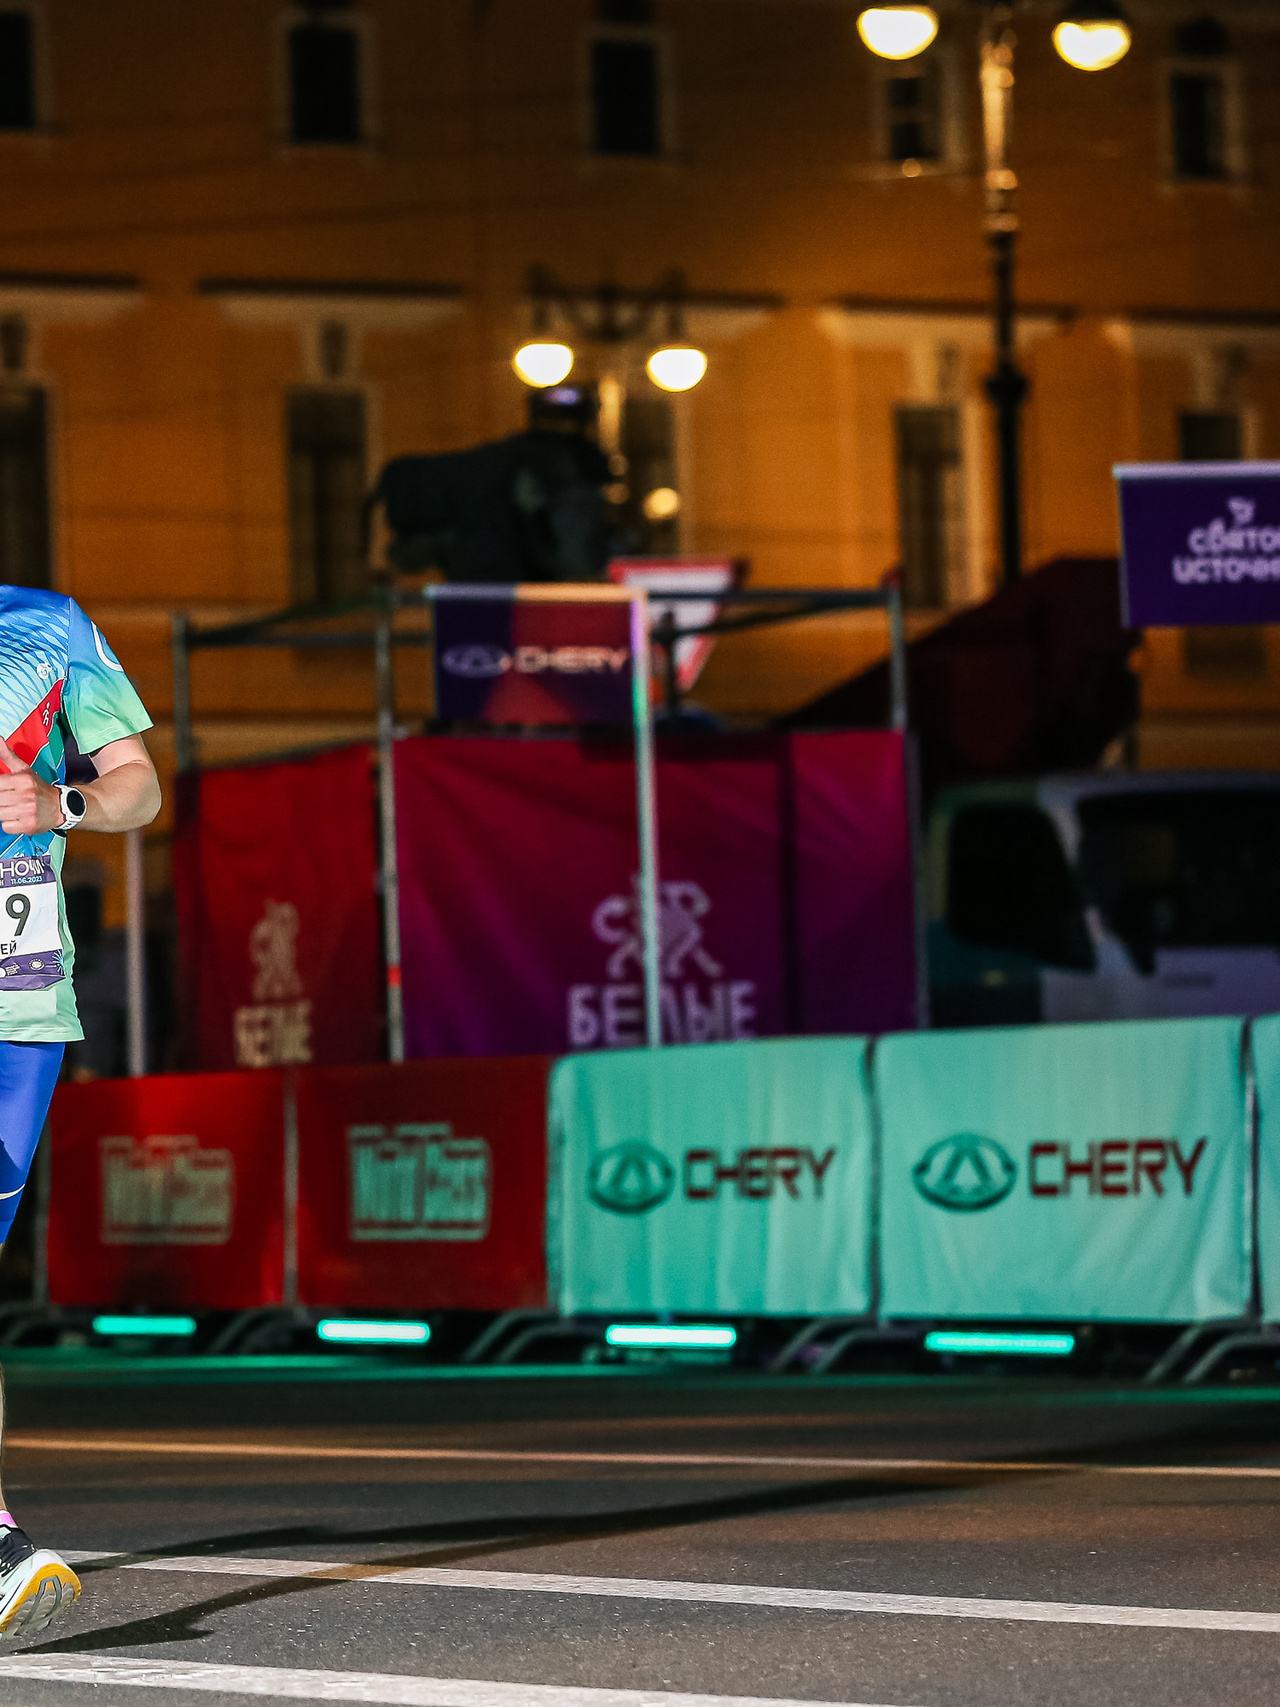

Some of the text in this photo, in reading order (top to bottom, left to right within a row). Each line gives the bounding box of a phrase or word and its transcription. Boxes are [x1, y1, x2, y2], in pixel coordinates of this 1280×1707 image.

[10, 876, 43, 885] 11.06.2023
[685, 1146, 836, 1200] CHERY
[1029, 1136, 1207, 1198] CHERY
